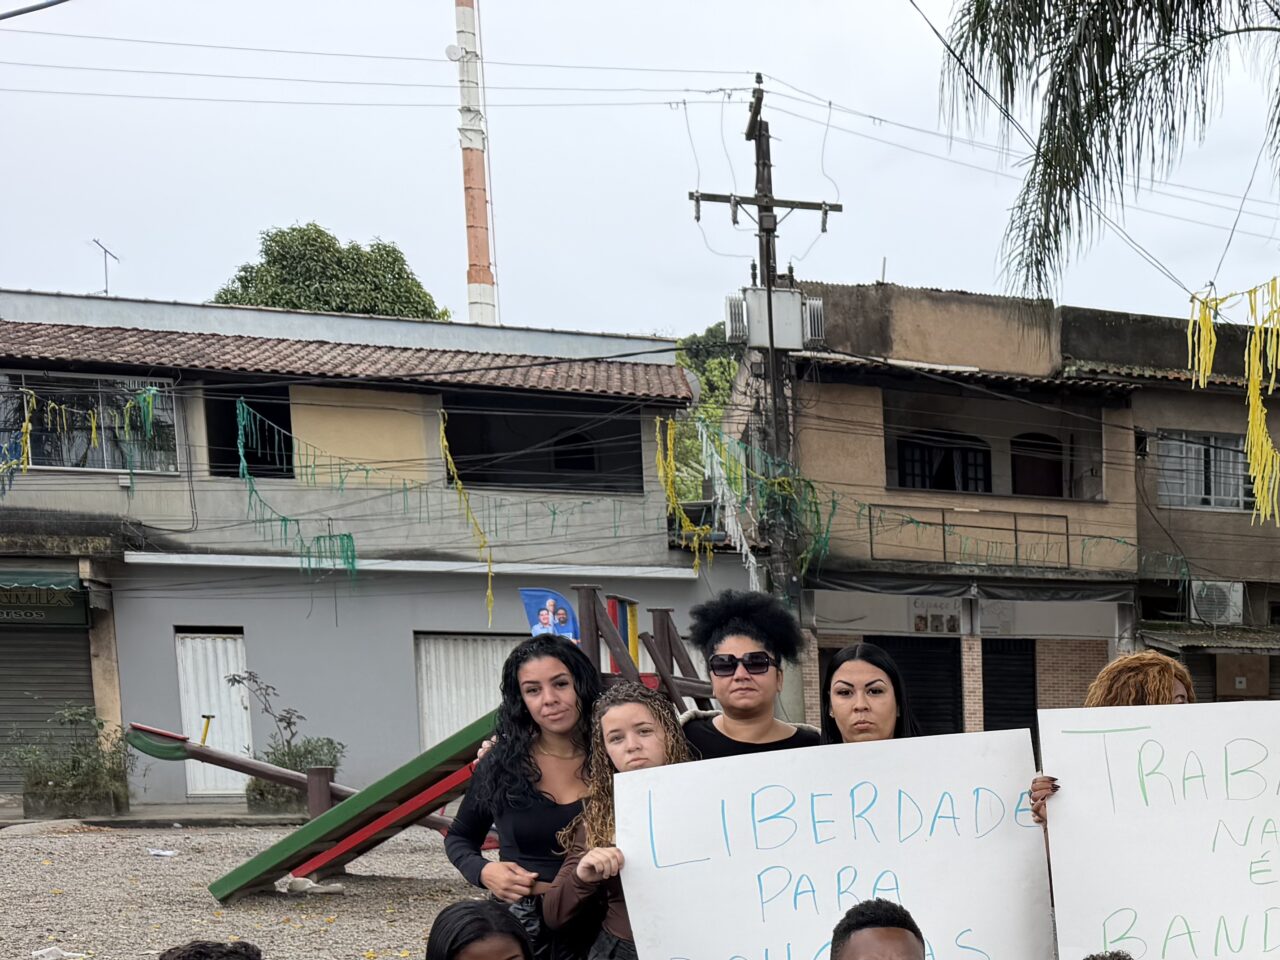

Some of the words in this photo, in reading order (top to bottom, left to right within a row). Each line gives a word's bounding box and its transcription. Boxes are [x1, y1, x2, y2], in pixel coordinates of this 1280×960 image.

[648, 781, 1041, 869] LIBERDADE
[757, 865, 901, 923] PARA
[1249, 850, 1279, 885] É
